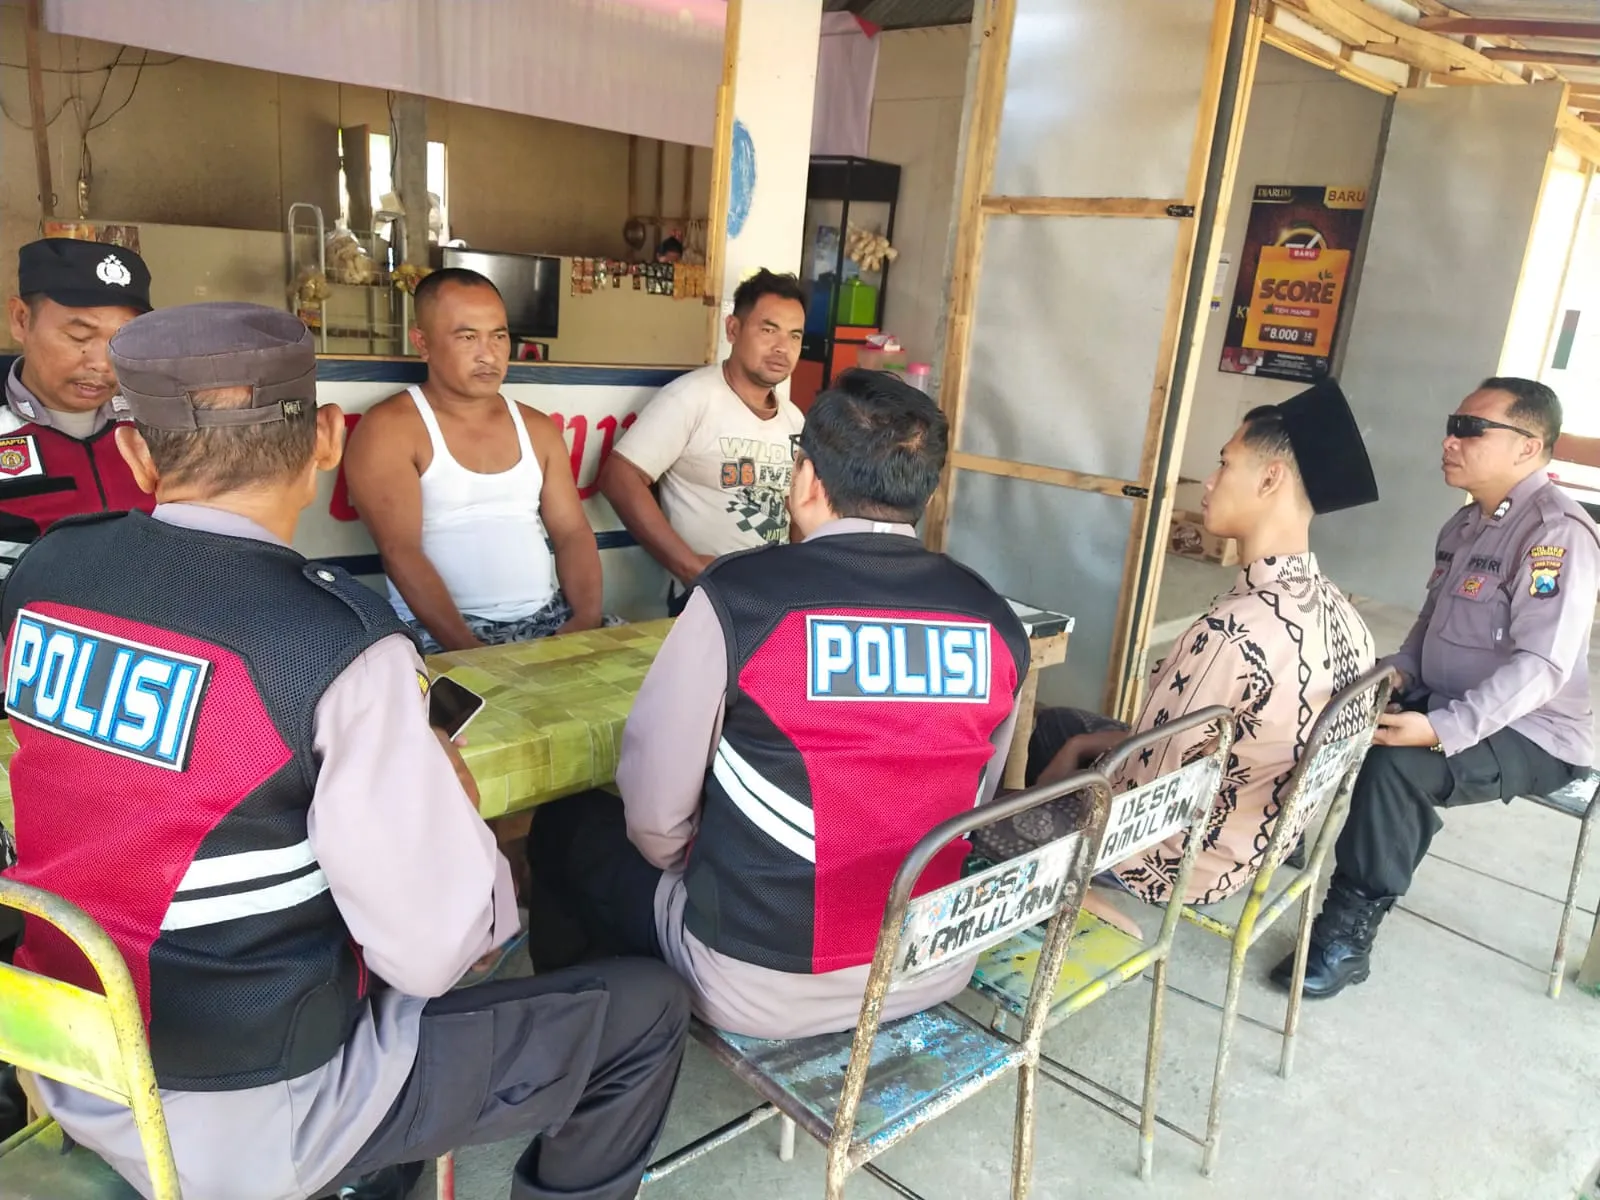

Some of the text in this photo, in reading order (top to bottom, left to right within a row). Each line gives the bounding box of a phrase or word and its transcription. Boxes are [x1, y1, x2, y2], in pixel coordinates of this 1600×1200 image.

[1328, 190, 1365, 202] BARU
[1294, 250, 1316, 258] BARU
[1259, 278, 1336, 304] SCORE
[813, 622, 987, 696] POLISI
[8, 618, 197, 760] POLISI
[1118, 777, 1180, 826] DESA
